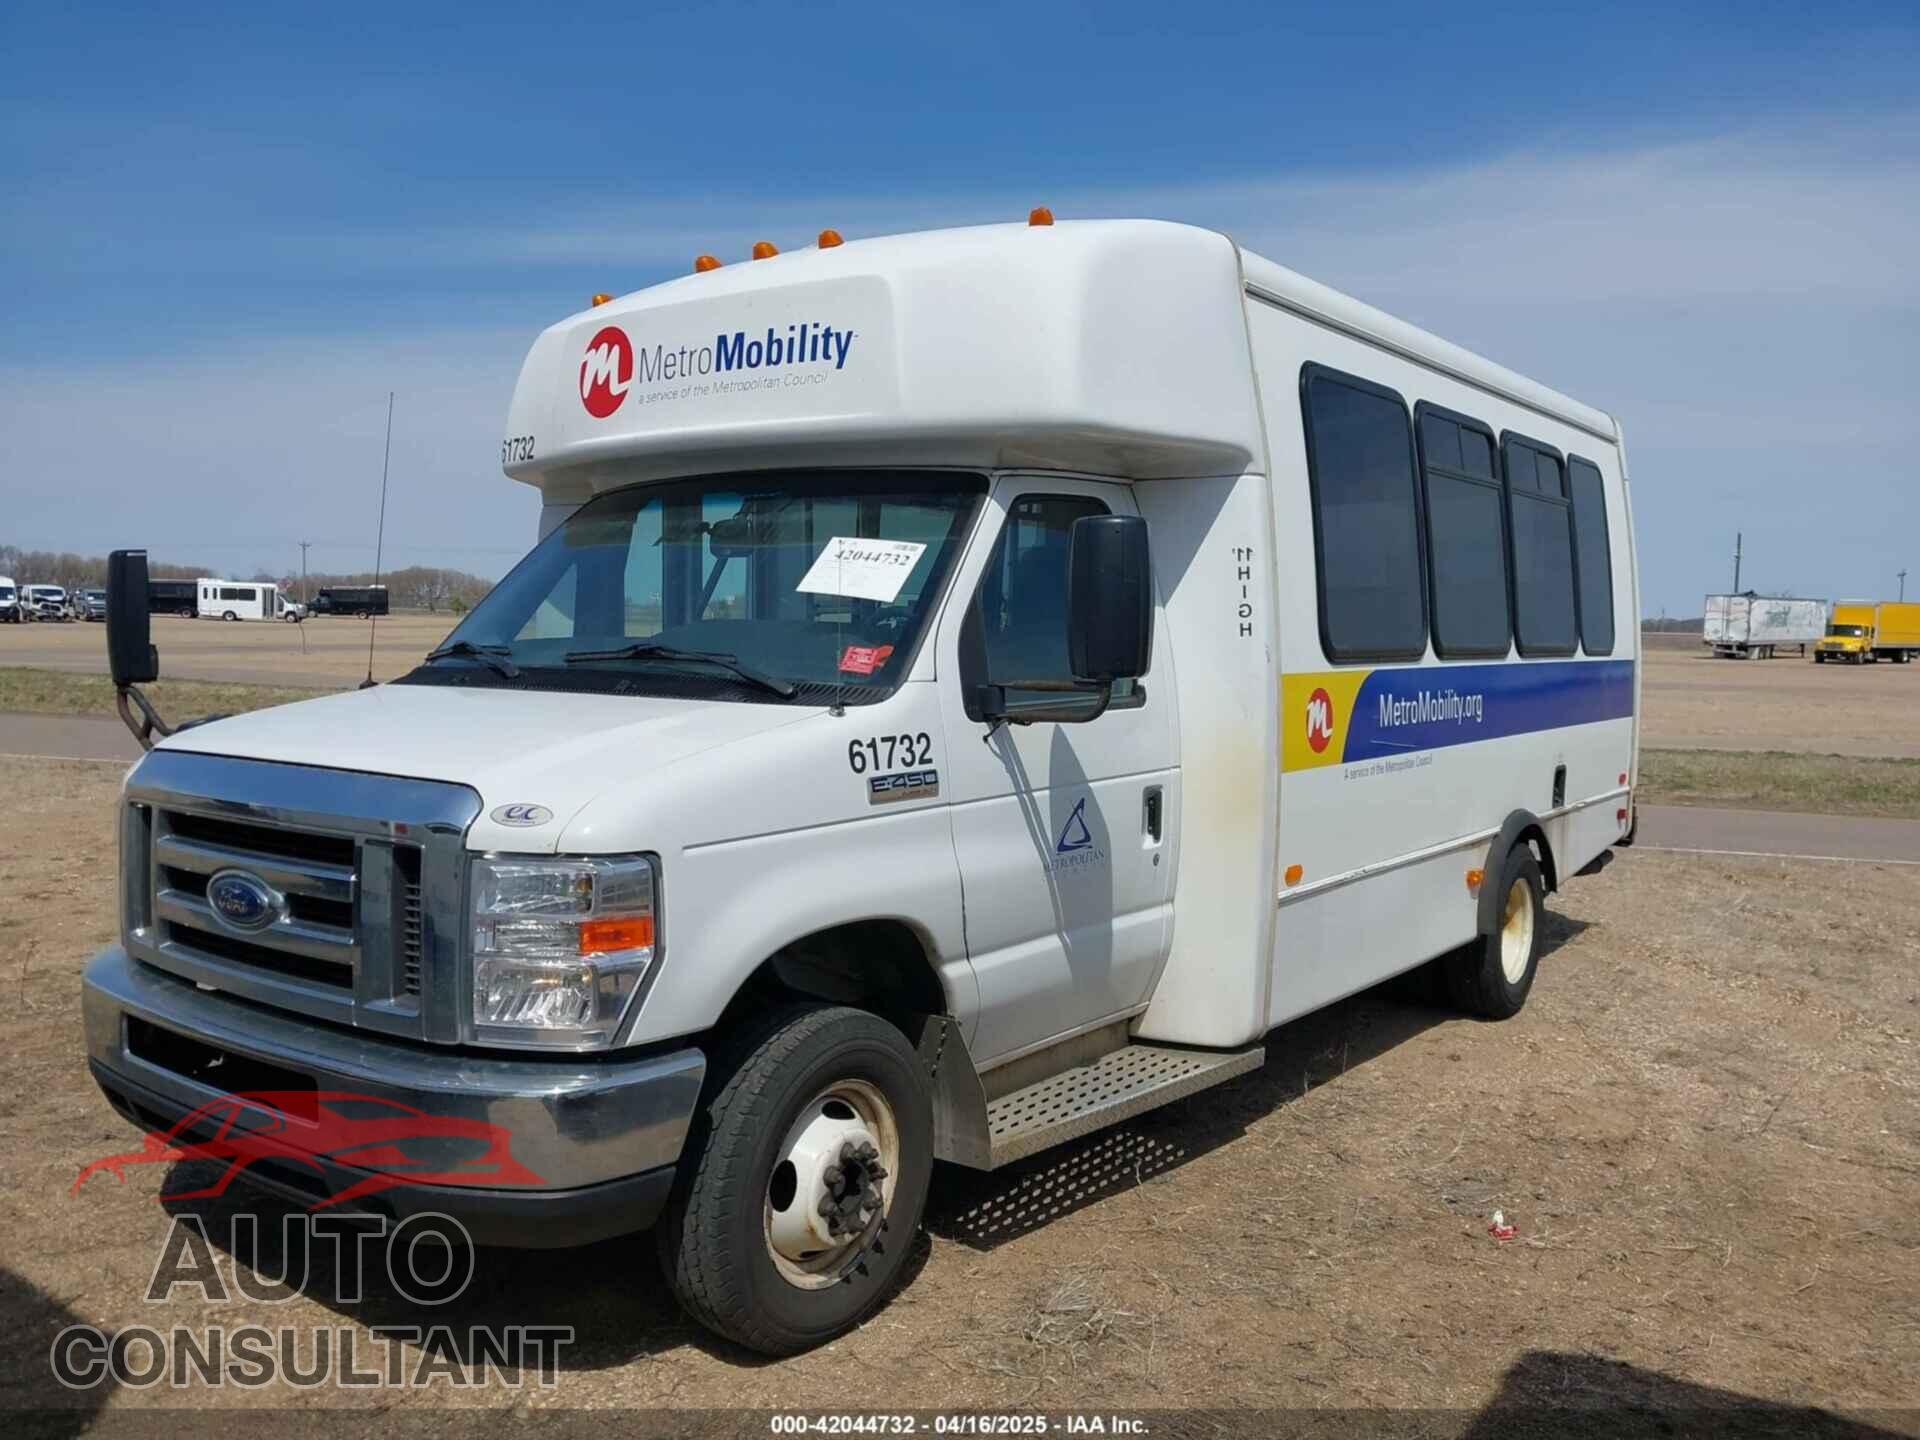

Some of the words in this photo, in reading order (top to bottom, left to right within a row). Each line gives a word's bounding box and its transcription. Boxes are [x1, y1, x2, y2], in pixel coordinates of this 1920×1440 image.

[639, 322, 854, 384] MetroMobility
[646, 388, 679, 404] service
[681, 384, 693, 400] of
[694, 381, 710, 398] the
[712, 375, 780, 396] Metropolitan
[783, 371, 829, 387] Council
[834, 549, 911, 566] 42044732
[1379, 688, 1483, 728] MetroMobility.org
[848, 731, 934, 774] 61732
